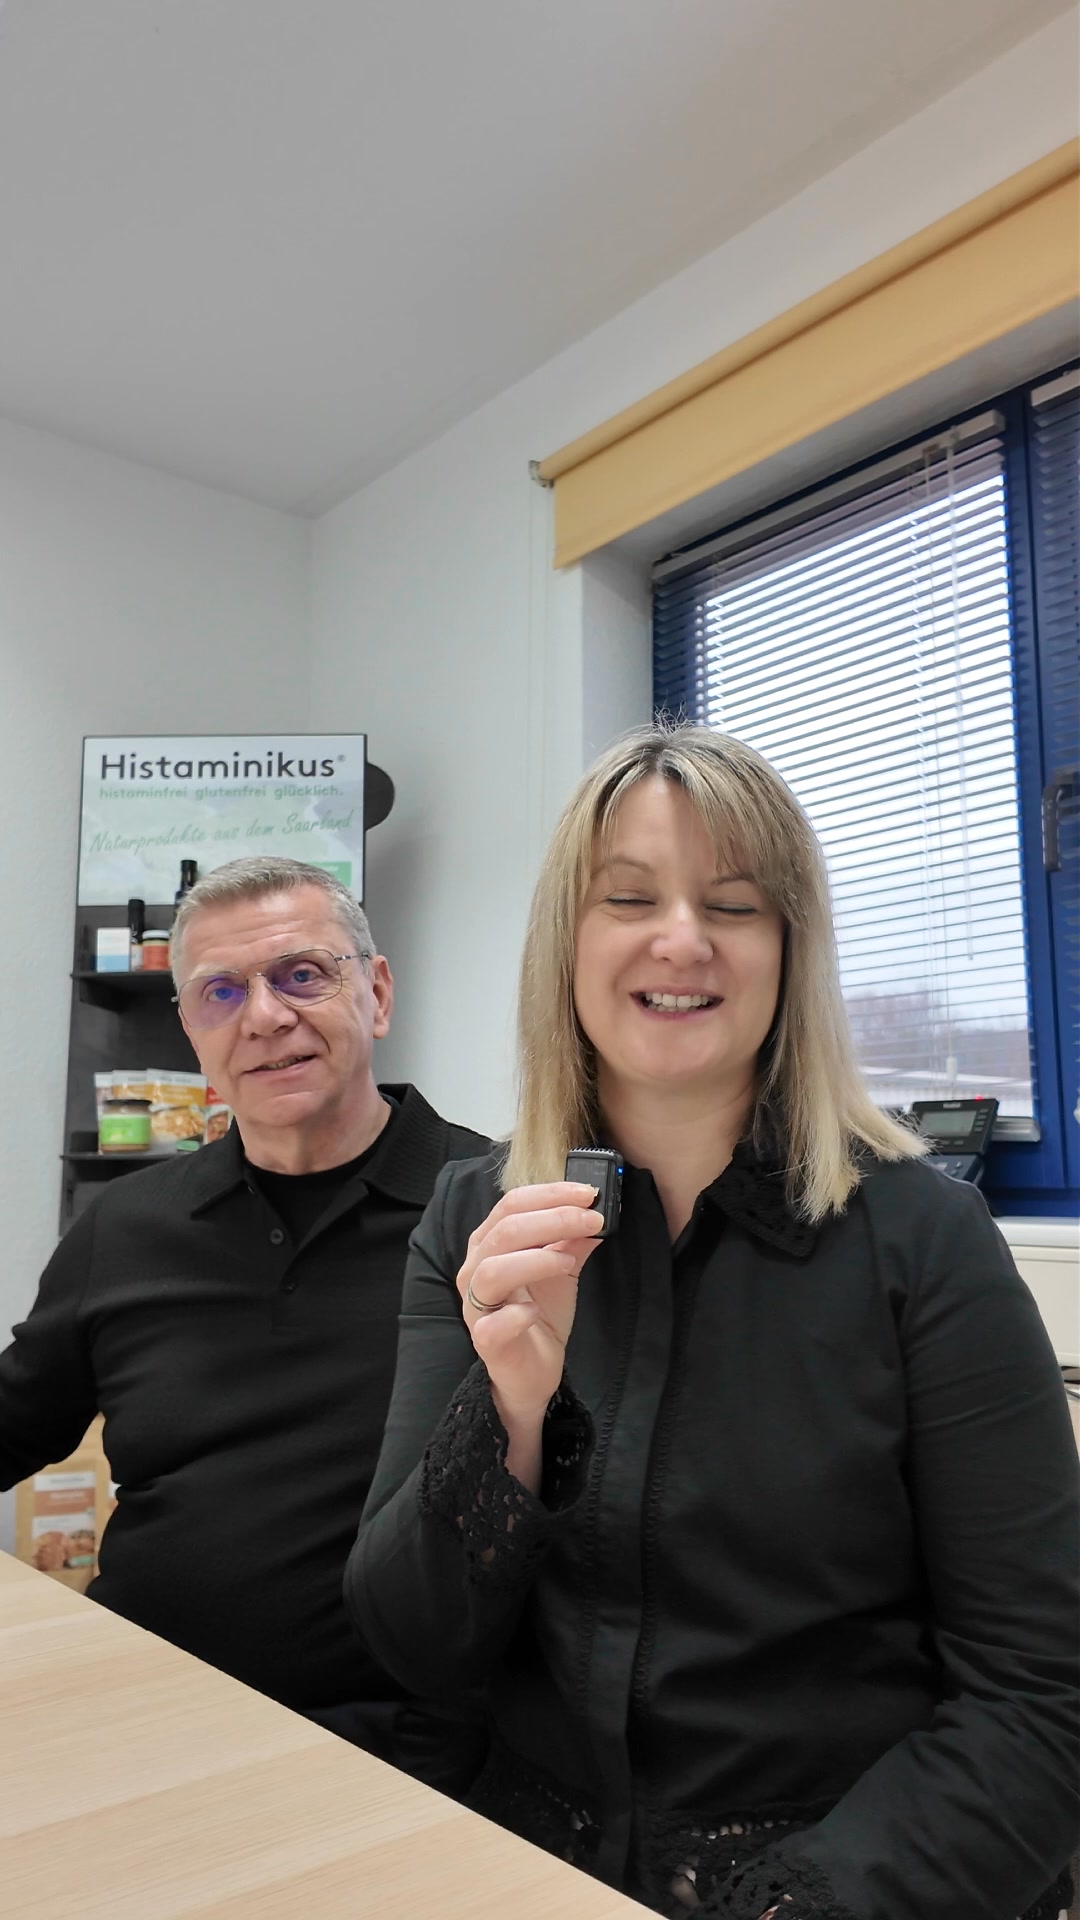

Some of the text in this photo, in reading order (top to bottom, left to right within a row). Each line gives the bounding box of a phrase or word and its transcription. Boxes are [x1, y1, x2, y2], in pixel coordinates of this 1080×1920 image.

[100, 783, 345, 801] histaminfrei glutenfrei glücklich.
[89, 809, 355, 856] Naturprodukte aus dem Saarland
